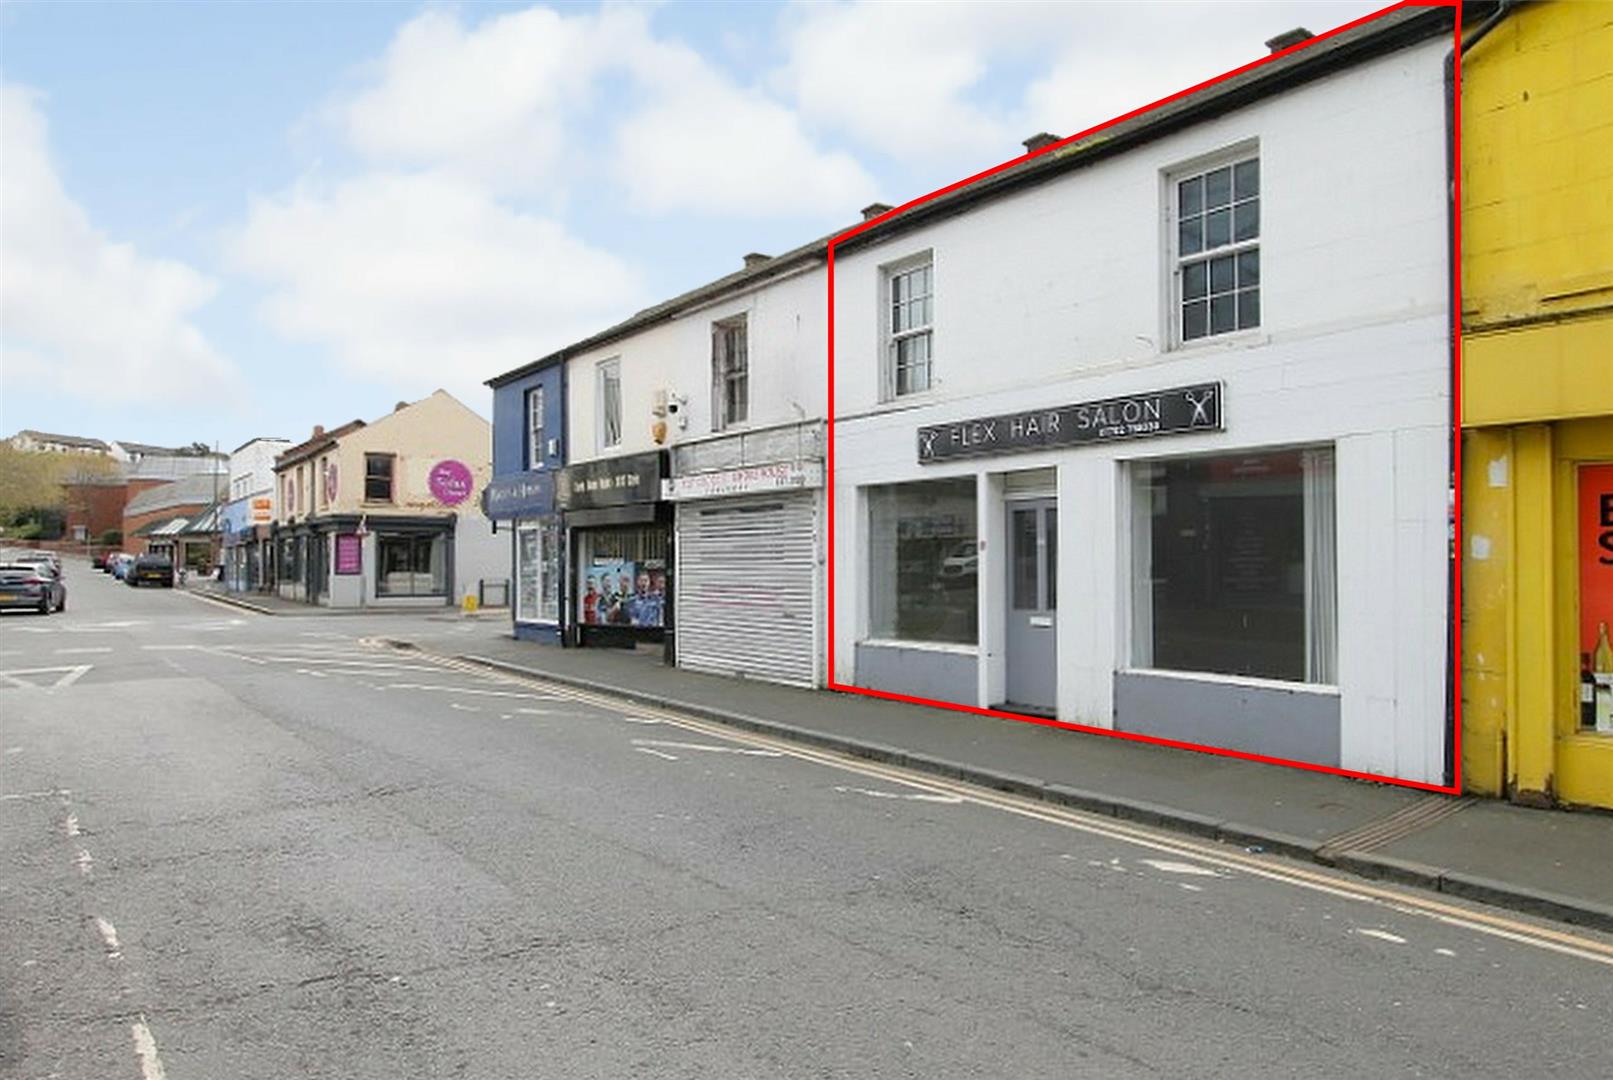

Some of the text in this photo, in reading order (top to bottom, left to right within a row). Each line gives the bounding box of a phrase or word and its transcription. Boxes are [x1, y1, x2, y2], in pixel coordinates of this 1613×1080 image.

[950, 398, 1161, 447] FLEX HAIR SALON
